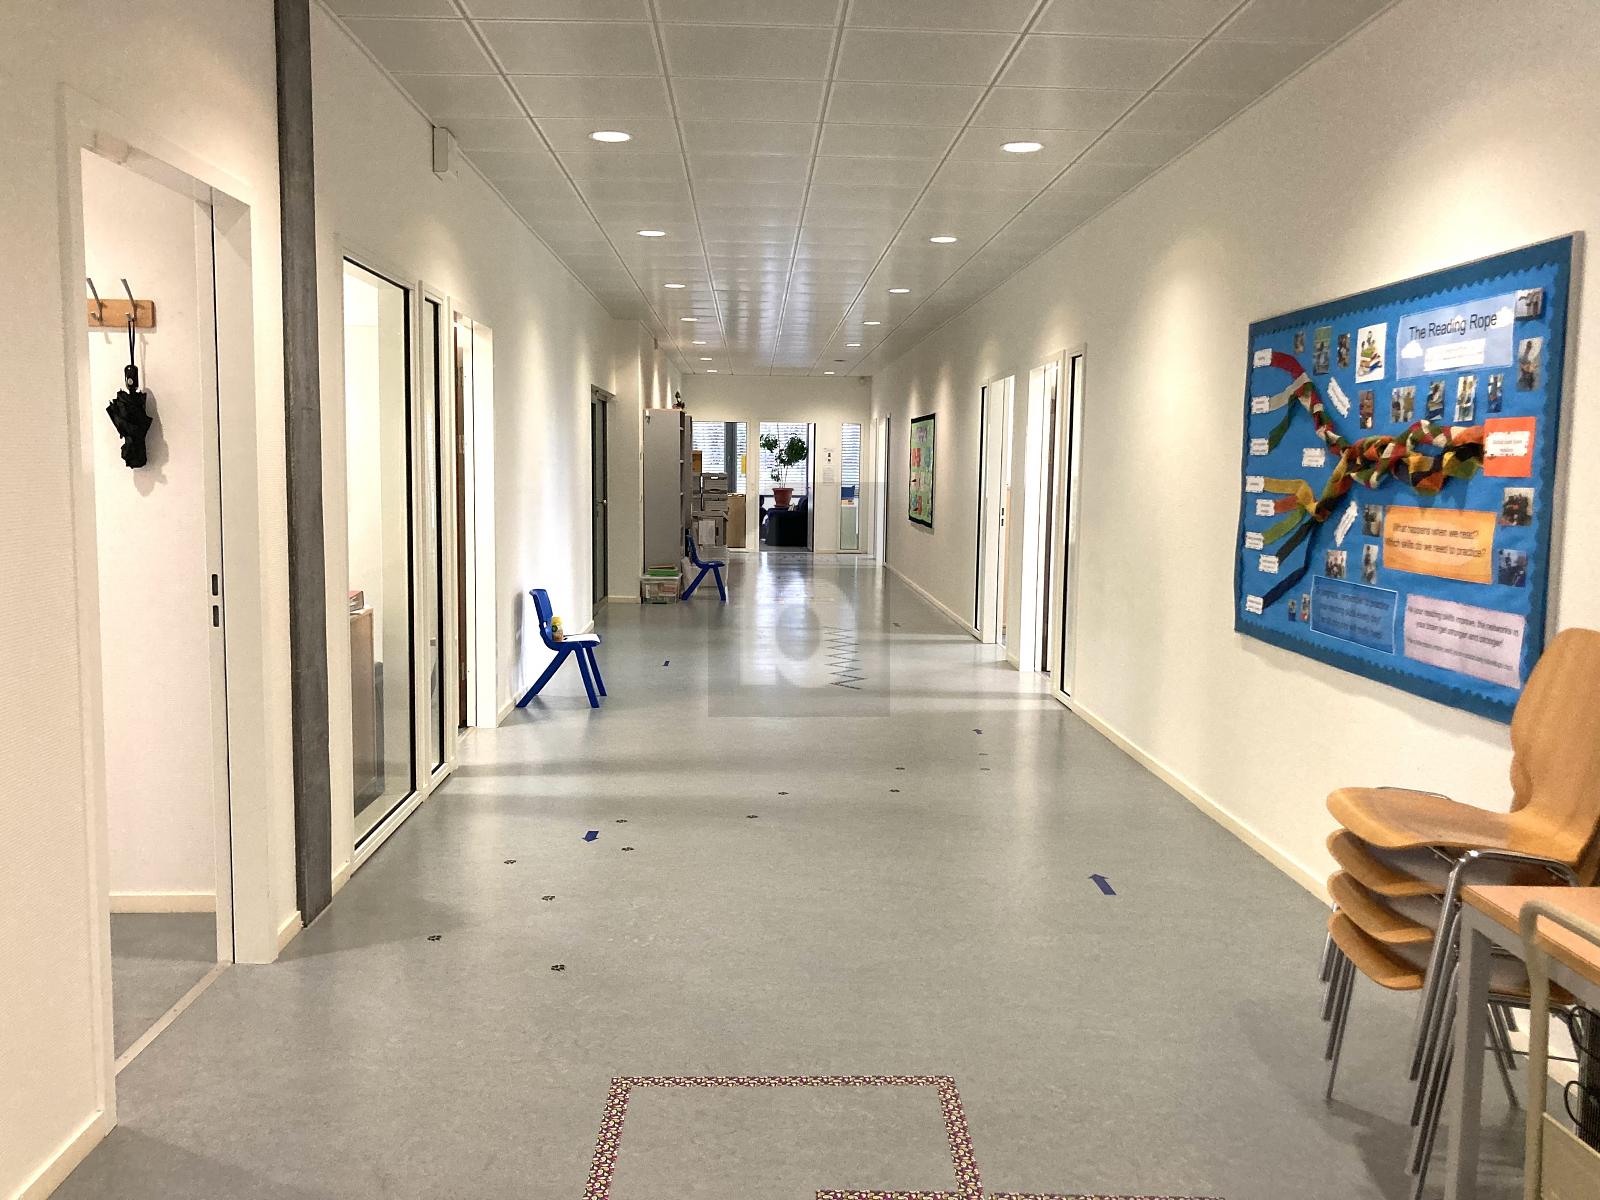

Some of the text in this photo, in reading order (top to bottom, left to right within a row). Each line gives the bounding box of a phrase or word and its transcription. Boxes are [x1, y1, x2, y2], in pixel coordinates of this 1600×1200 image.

[1409, 313, 1498, 339] The Reading Rope
[1431, 528, 1447, 537] when
[1449, 530, 1459, 538] we
[1423, 543, 1432, 551] we
